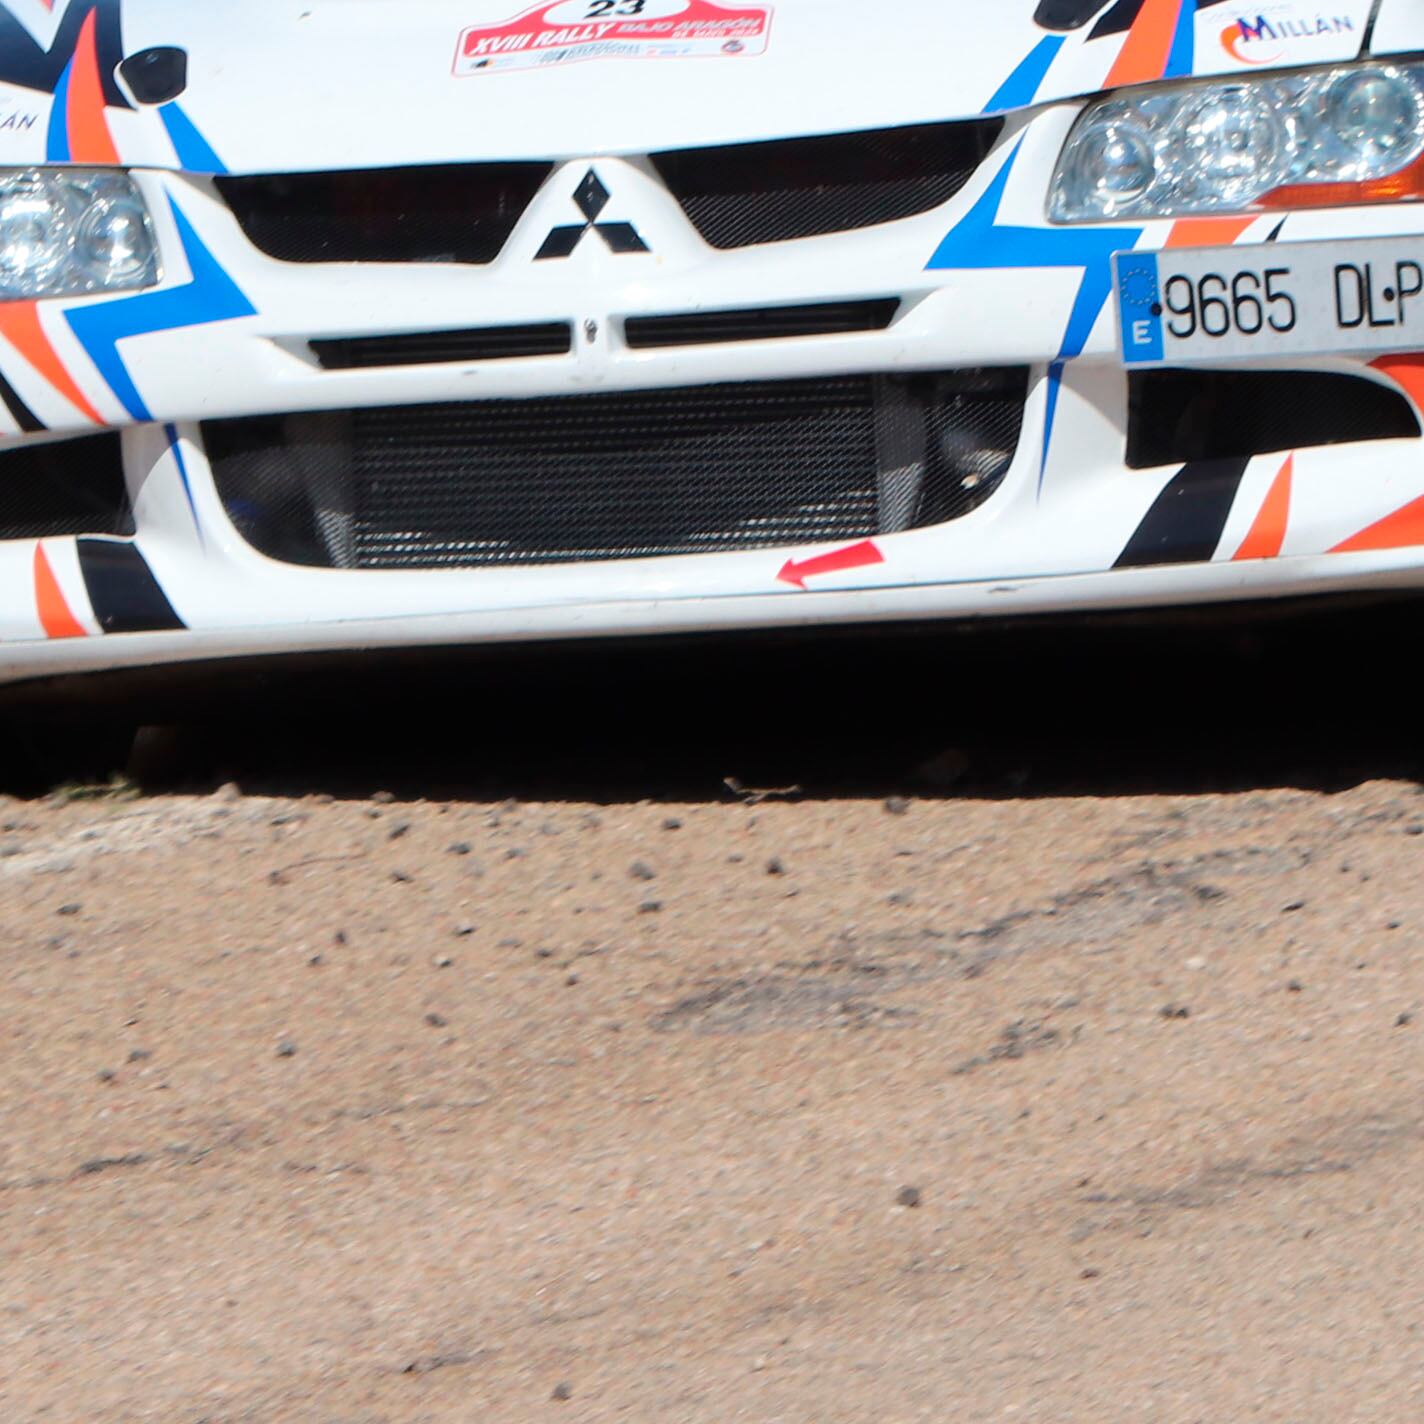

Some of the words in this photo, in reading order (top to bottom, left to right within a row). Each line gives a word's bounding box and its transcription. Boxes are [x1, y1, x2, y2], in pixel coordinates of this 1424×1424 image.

[470, 32, 532, 57] XVIII
[532, 22, 617, 48] RALLY
[1164, 267, 1297, 340] 9665
[1333, 260, 1424, 329] DLP
[1132, 320, 1153, 345] E
